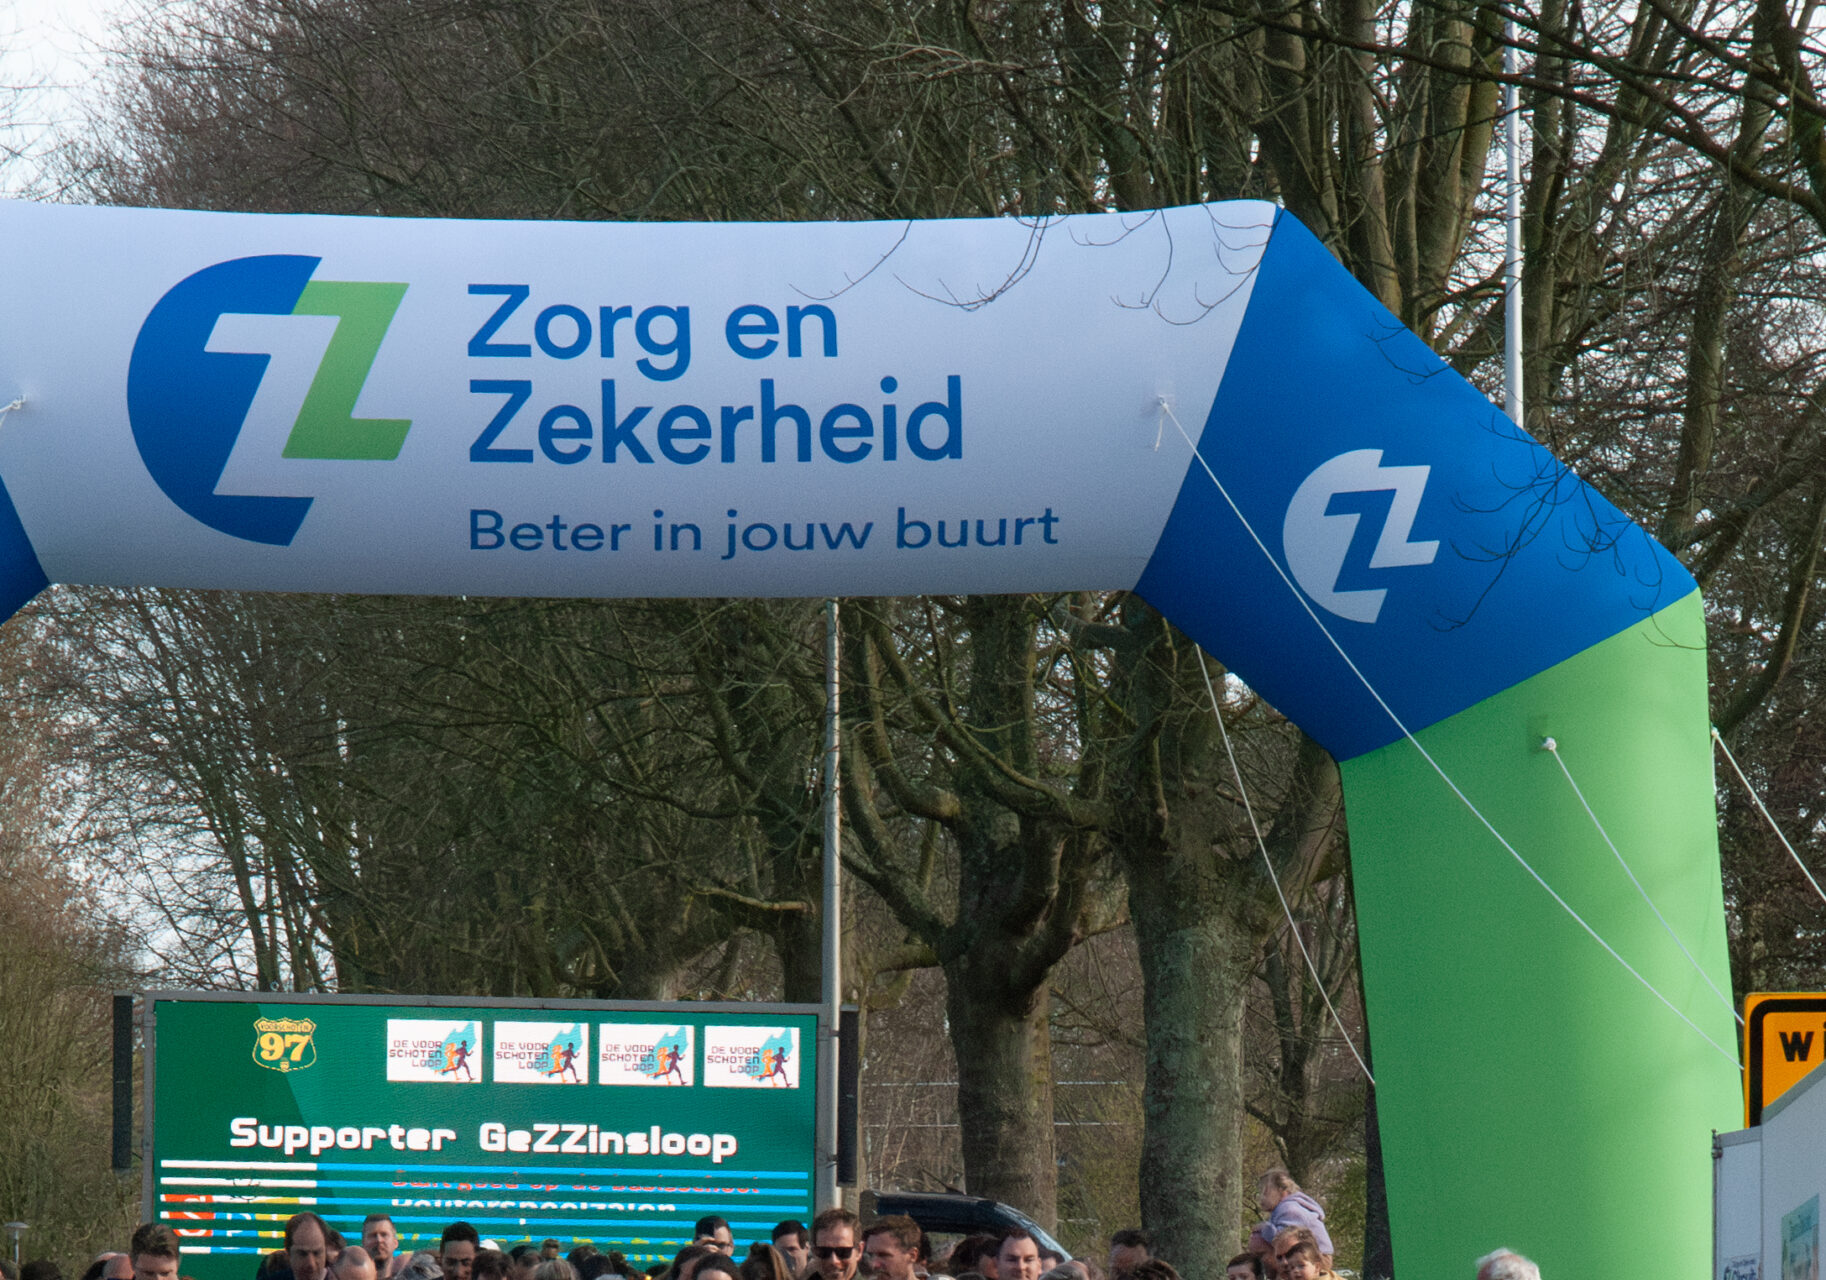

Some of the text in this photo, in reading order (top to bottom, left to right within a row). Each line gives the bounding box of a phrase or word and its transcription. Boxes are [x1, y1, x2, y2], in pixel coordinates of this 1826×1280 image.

[467, 283, 839, 383] Zorg en
[469, 374, 963, 466] Zekerheid
[469, 506, 1059, 561] Beter in jouw buurt
[260, 1033, 311, 1061] 97
[394, 1040, 442, 1049] DE VOOR
[500, 1042, 549, 1050] DE VOOR
[606, 1044, 655, 1053] DE VOOR
[389, 1050, 442, 1058] SCHOTEN
[712, 1046, 760, 1055] DE VOOR
[496, 1051, 548, 1060] SCHOTEN
[601, 1053, 654, 1062] SCHOTEN
[707, 1055, 760, 1064] SCHOTEN
[412, 1059, 442, 1067] LOOP
[519, 1061, 548, 1069] LOOP
[624, 1063, 654, 1071] LOOP
[730, 1065, 760, 1073] LOOP
[229, 1117, 738, 1164] Supporter GeZZinsloop
